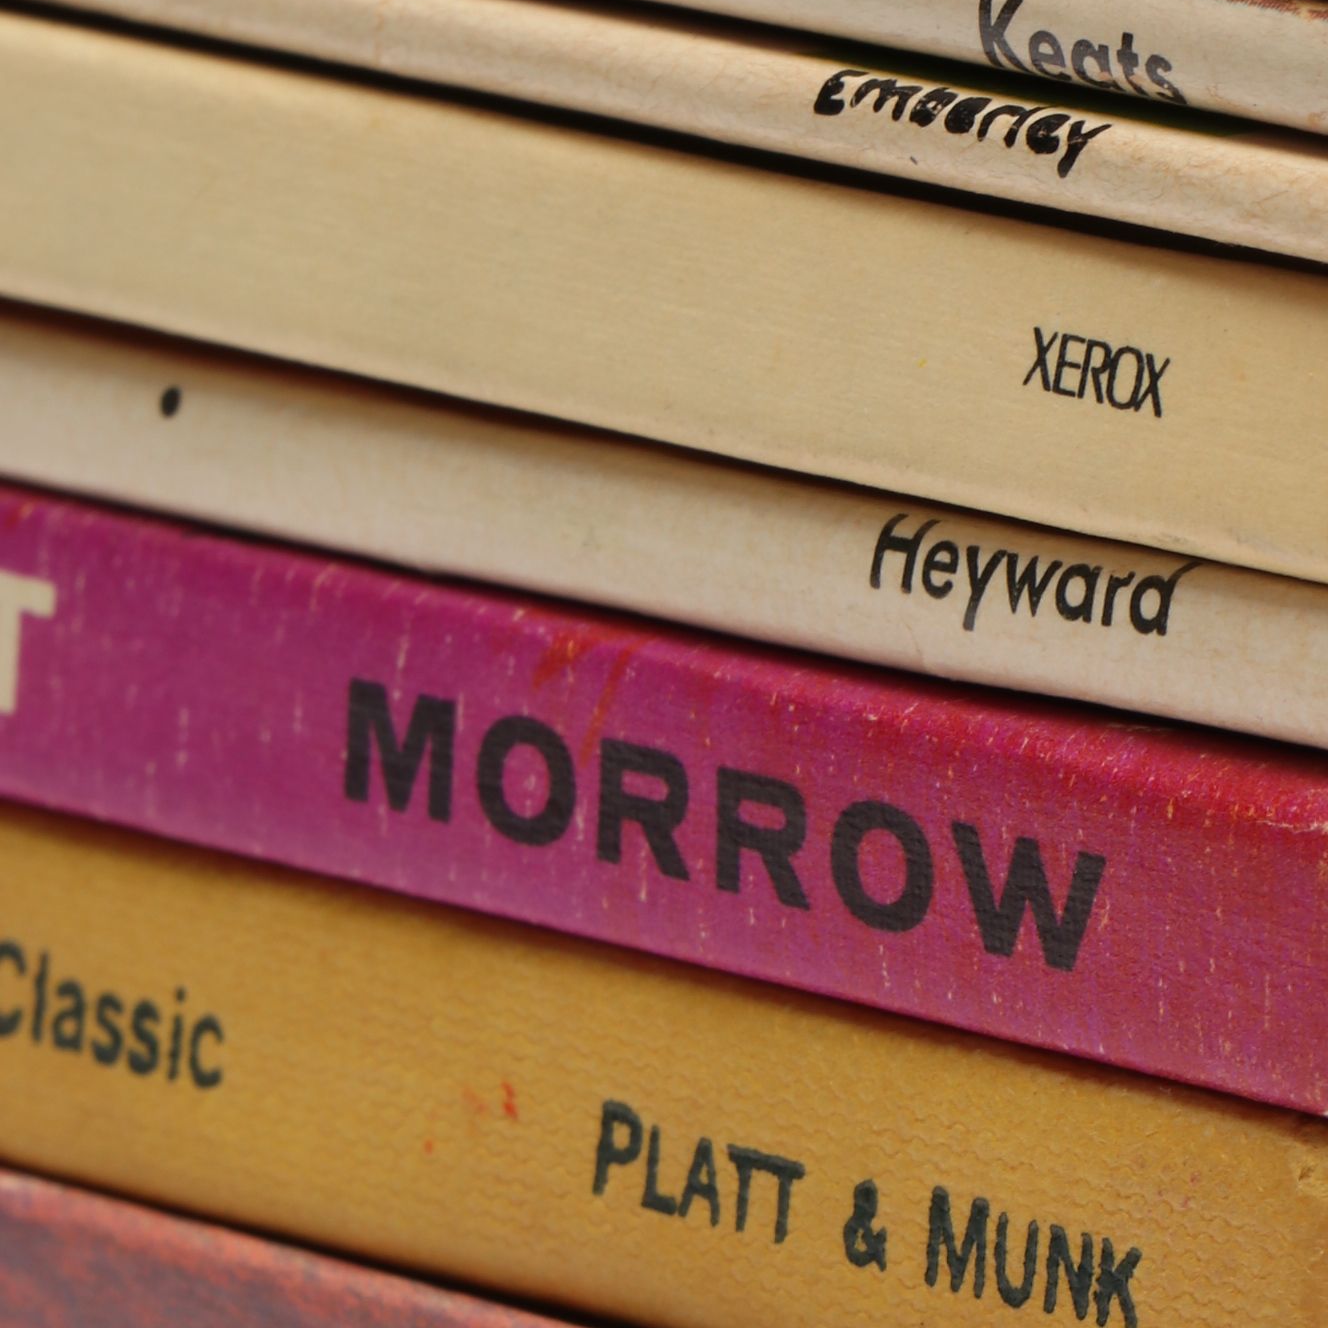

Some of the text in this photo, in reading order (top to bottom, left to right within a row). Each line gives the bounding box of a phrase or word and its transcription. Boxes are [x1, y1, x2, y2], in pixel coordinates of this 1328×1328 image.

[1022, 326, 1171, 419] XEROX
[869, 512, 1201, 637] Heyward
[343, 677, 1107, 971] MORROW
[0, 939, 224, 1090] Classic
[592, 1099, 806, 1244] PLATT
[842, 1178, 888, 1272] &
